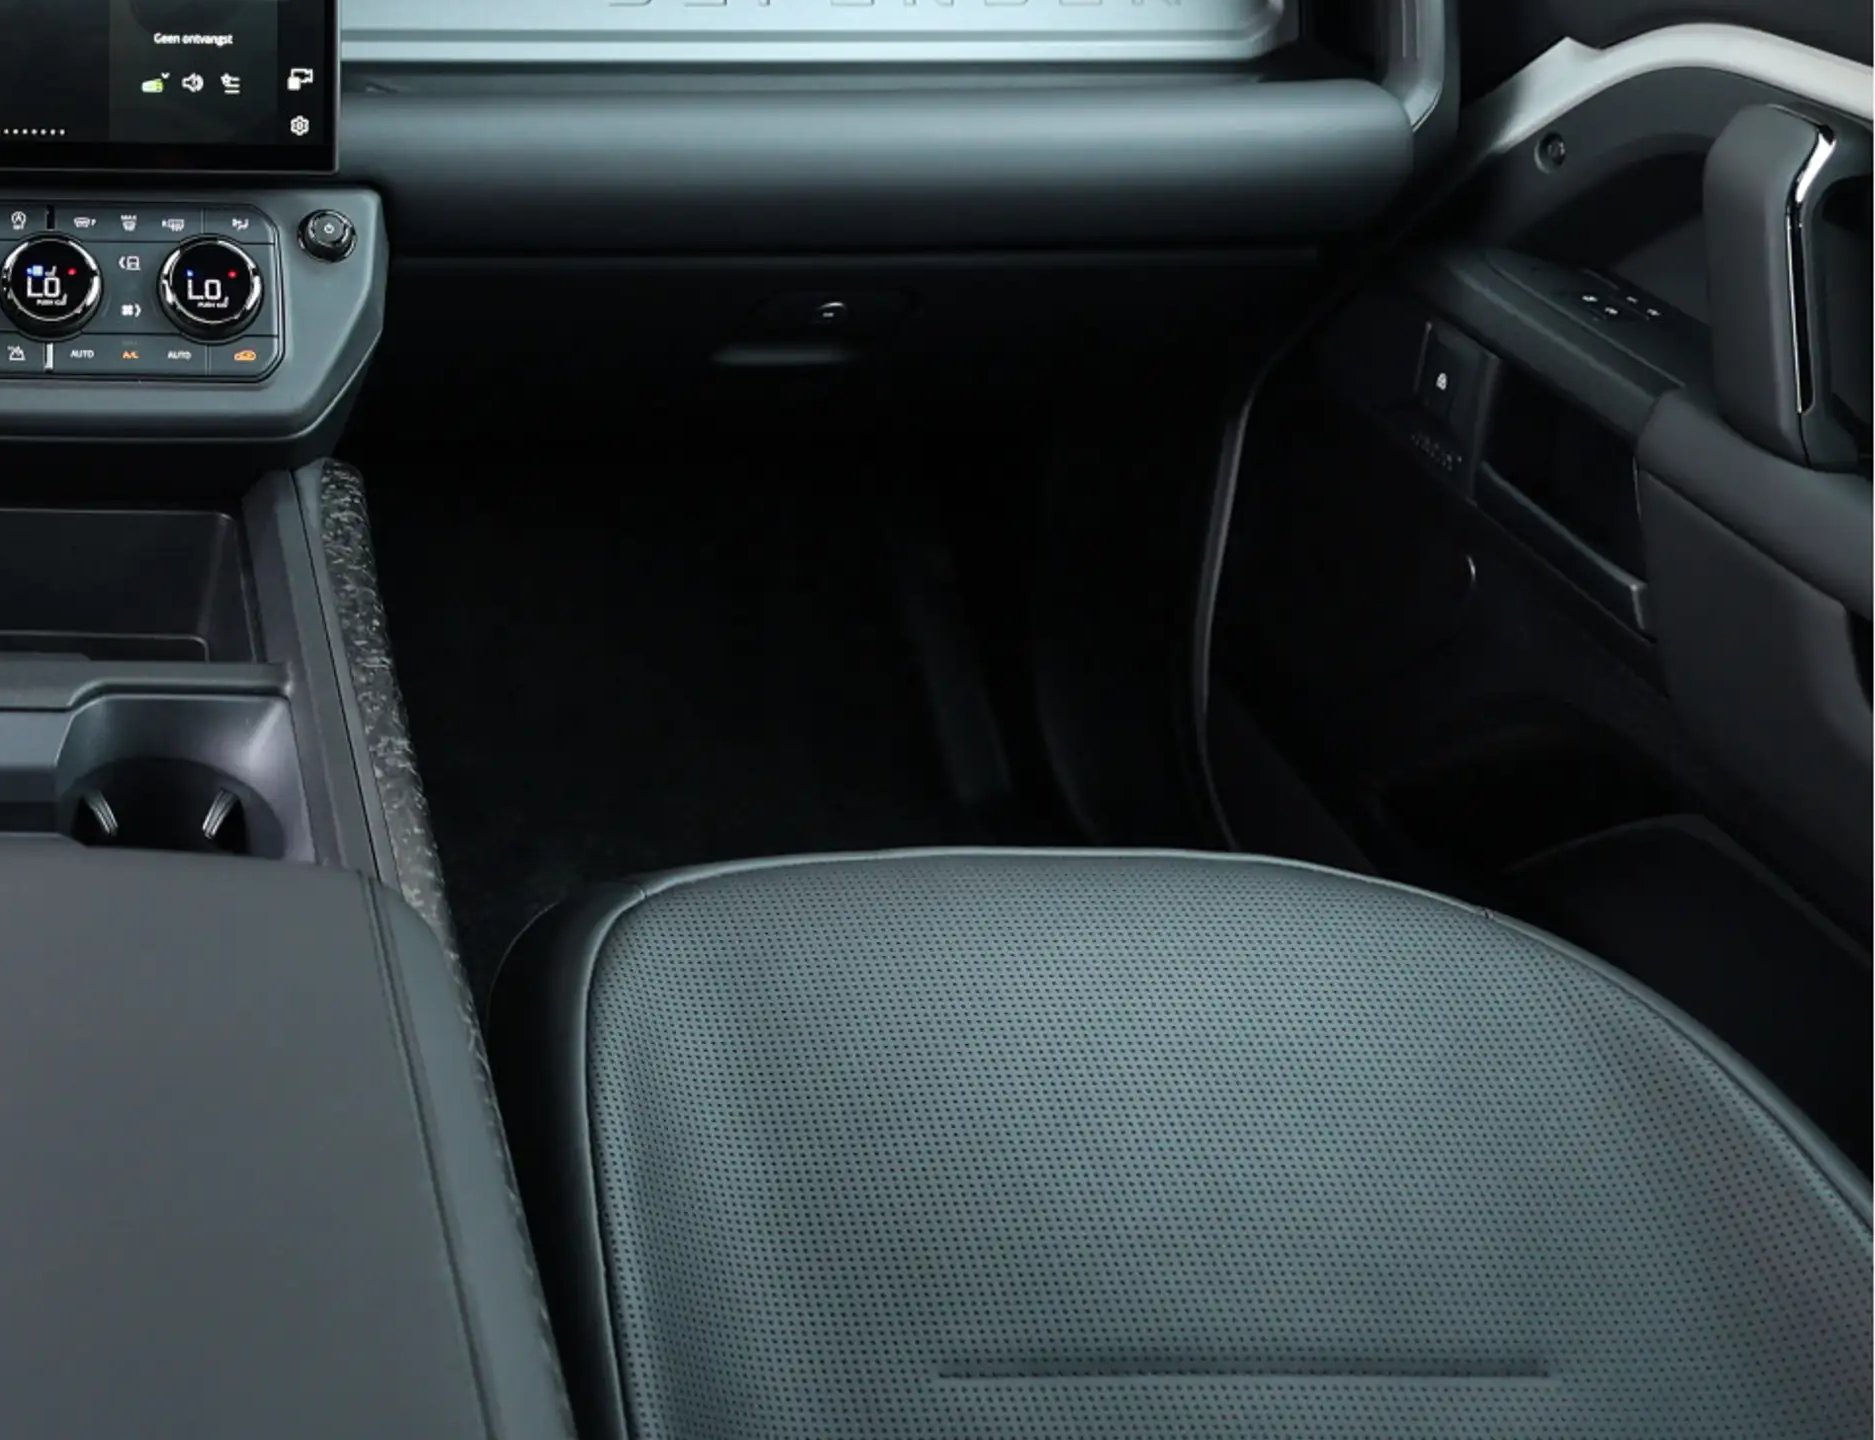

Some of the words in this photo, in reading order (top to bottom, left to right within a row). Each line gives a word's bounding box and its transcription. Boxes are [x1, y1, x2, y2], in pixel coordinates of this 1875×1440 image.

[154, 32, 180, 44] Geen
[182, 34, 233, 47] ontvangst
[27, 276, 61, 298] LO
[187, 279, 222, 300] LO
[70, 350, 95, 359] AUTO
[167, 351, 192, 360] AUTO
